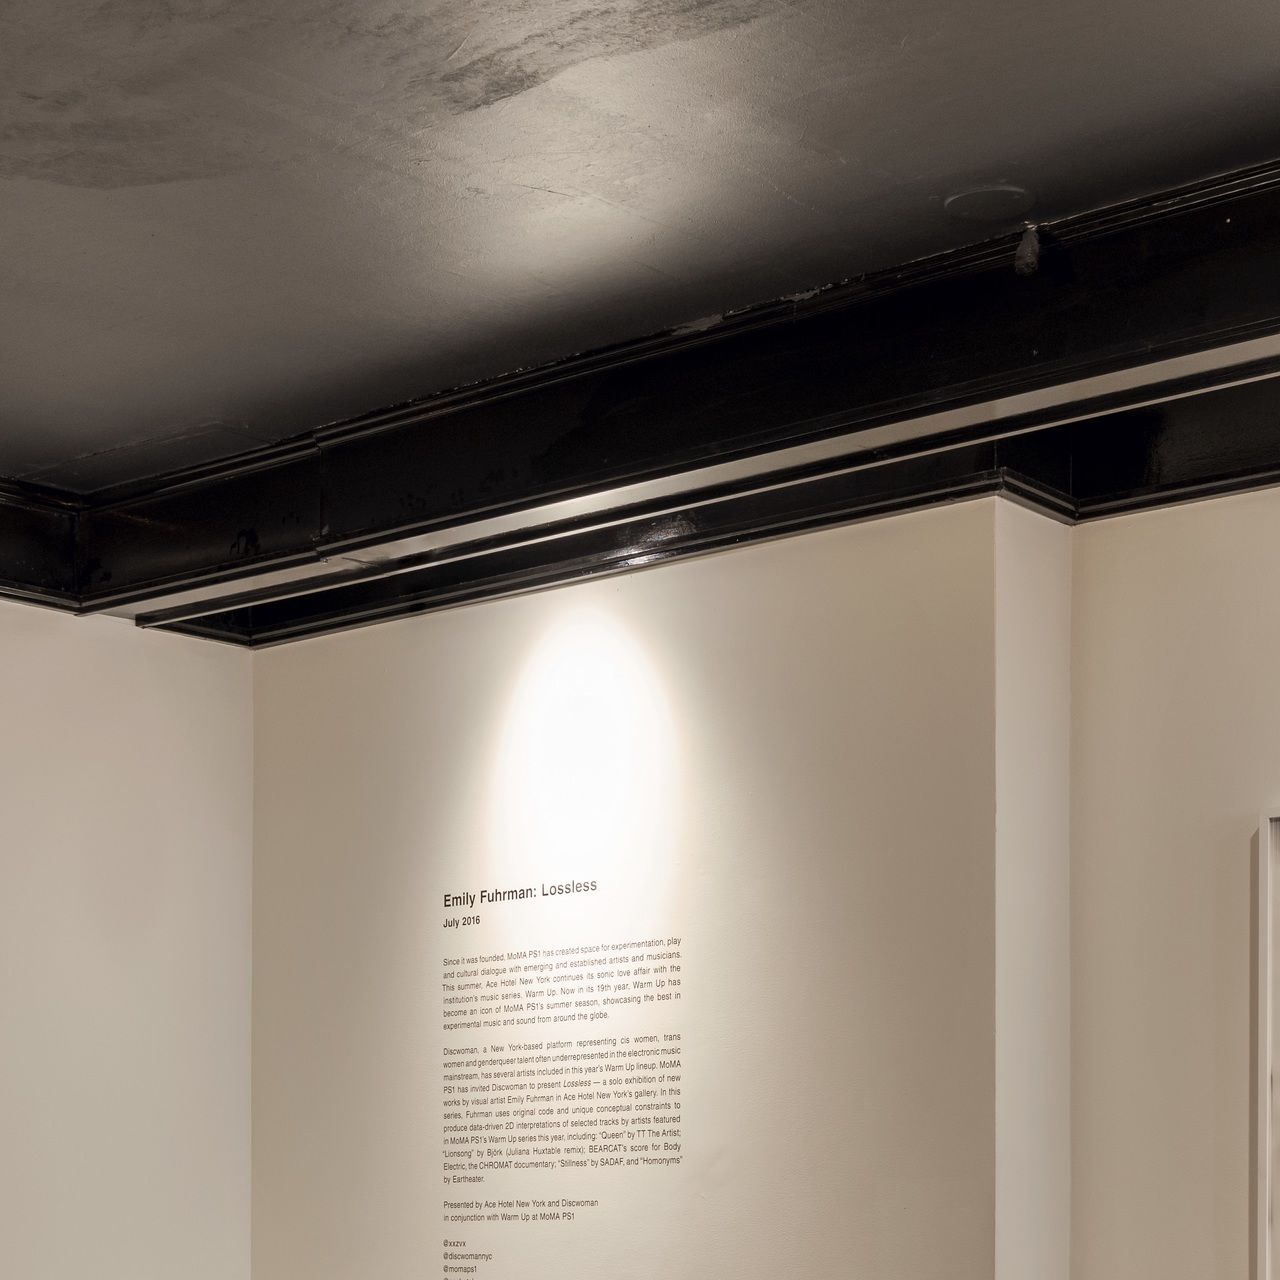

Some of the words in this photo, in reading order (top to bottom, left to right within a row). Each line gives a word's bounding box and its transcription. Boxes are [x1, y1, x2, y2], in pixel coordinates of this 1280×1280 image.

[444, 892, 476, 908] Emily
[542, 880, 597, 896] Lossless
[443, 918, 460, 929] July
[462, 916, 480, 926] 2016
[443, 958, 460, 966] Since
[507, 951, 527, 960] MoMA
[529, 949, 541, 958] PS1
[667, 937, 682, 948] play
[443, 970, 455, 979] and
[480, 967, 507, 976] dialogue
[631, 954, 644, 963] and
[442, 983, 455, 992] This
[486, 980, 498, 988] Ace
[500, 978, 517, 987] Hotel
[519, 977, 534, 985] New
[633, 967, 651, 976] affair
[653, 965, 667, 974] with
[670, 964, 681, 973] the
[525, 990, 544, 998] Warm
[597, 983, 611, 992] 19th
[633, 981, 653, 990] Warm
[655, 979, 666, 989] Up
[668, 978, 681, 987] has
[443, 1009, 467, 1017] become
[495, 1005, 501, 1013] of
[504, 1003, 524, 1013] MoMA
[644, 994, 654, 1002] the
[657, 993, 672, 1001] best
[675, 992, 681, 1000] in
[483, 1018, 501, 1027] music
[503, 1017, 515, 1026] and
[516, 1016, 536, 1025] sound
[537, 1015, 552, 1023] from
[553, 1013, 576, 1022] around
[491, 1044, 505, 1053] New
[620, 1036, 630, 1044] cis
[664, 1034, 681, 1042] trans
[465, 1059, 477, 1067] and
[517, 1056, 534, 1064] talent
[535, 1055, 551, 1063] often
[609, 1050, 615, 1059] in
[616, 1050, 627, 1058] the
[661, 1046, 681, 1056] music
[481, 1071, 492, 1079] has
[493, 1069, 515, 1078] several
[516, 1069, 536, 1077] artists
[537, 1067, 563, 1076] included
[571, 1066, 583, 1074] this
[605, 1064, 624, 1072] Warm
[625, 1063, 635, 1073] Up
[659, 1060, 681, 1069] MoMA
[443, 1085, 455, 1094] PS1
[457, 1085, 469, 1093] has
[470, 1084, 490, 1092] invited
[492, 1083, 527, 1091] Discwoman
[537, 1080, 561, 1091] present
[563, 1079, 591, 1088] Lossless
[609, 1077, 623, 1085] solo
[658, 1074, 665, 1083] of
[667, 1075, 681, 1083] new
[443, 1098, 461, 1106] works
[462, 1098, 470, 1107] by
[471, 1097, 489, 1105] visual
[490, 1096, 506, 1104] artist
[507, 1095, 524, 1105] Emily
[526, 1094, 554, 1103] Fuhrman
[556, 1093, 562, 1101] in
[563, 1093, 576, 1101] Ace
[578, 1091, 594, 1100] Hotel
[596, 1091, 611, 1099] New
[660, 1088, 667, 1096] In
[669, 1087, 681, 1096] this
[466, 1110, 493, 1118] Fuhrman
[513, 1107, 536, 1118] original
[538, 1107, 554, 1115] code
[557, 1106, 569, 1114] and
[572, 1105, 594, 1115] unique
[443, 1124, 468, 1134] produce
[505, 1121, 514, 1130] 2D
[562, 1119, 569, 1127] of
[571, 1118, 598, 1127] selected
[599, 1117, 619, 1126] tracks
[621, 1117, 629, 1127] by
[631, 1116, 651, 1125] artists
[653, 1115, 681, 1124] featured
[450, 1136, 470, 1145] MoMA
[488, 1135, 507, 1143] Warm
[508, 1135, 517, 1144] Up
[518, 1134, 537, 1142] series
[627, 1130, 635, 1140] by
[637, 1130, 646, 1138] TT
[647, 1129, 660, 1138] The
[477, 1149, 484, 1158] by
[533, 1146, 561, 1155] Huxtable
[651, 1143, 661, 1151] for
[664, 1142, 681, 1152] Body
[468, 1162, 478, 1170] the
[479, 1161, 513, 1169] CHROMAT
[591, 1158, 599, 1168] by
[626, 1157, 639, 1165] and
[443, 1175, 451, 1185] by
[443, 1200, 474, 1209] Presented
[475, 1200, 483, 1210] by
[484, 1200, 497, 1208] Ace
[498, 1200, 514, 1208] Hotel
[516, 1200, 530, 1208] New
[532, 1199, 546, 1207] York
[547, 1199, 560, 1207] and
[561, 1199, 599, 1207] Discwoman
[442, 1214, 449, 1222] in
[486, 1213, 499, 1221] with
[500, 1213, 519, 1221] Warm
[521, 1213, 530, 1222] Up
[540, 1212, 560, 1220] MoMA
[562, 1212, 575, 1220] PS1
[443, 1265, 477, 1275] @momaps1
